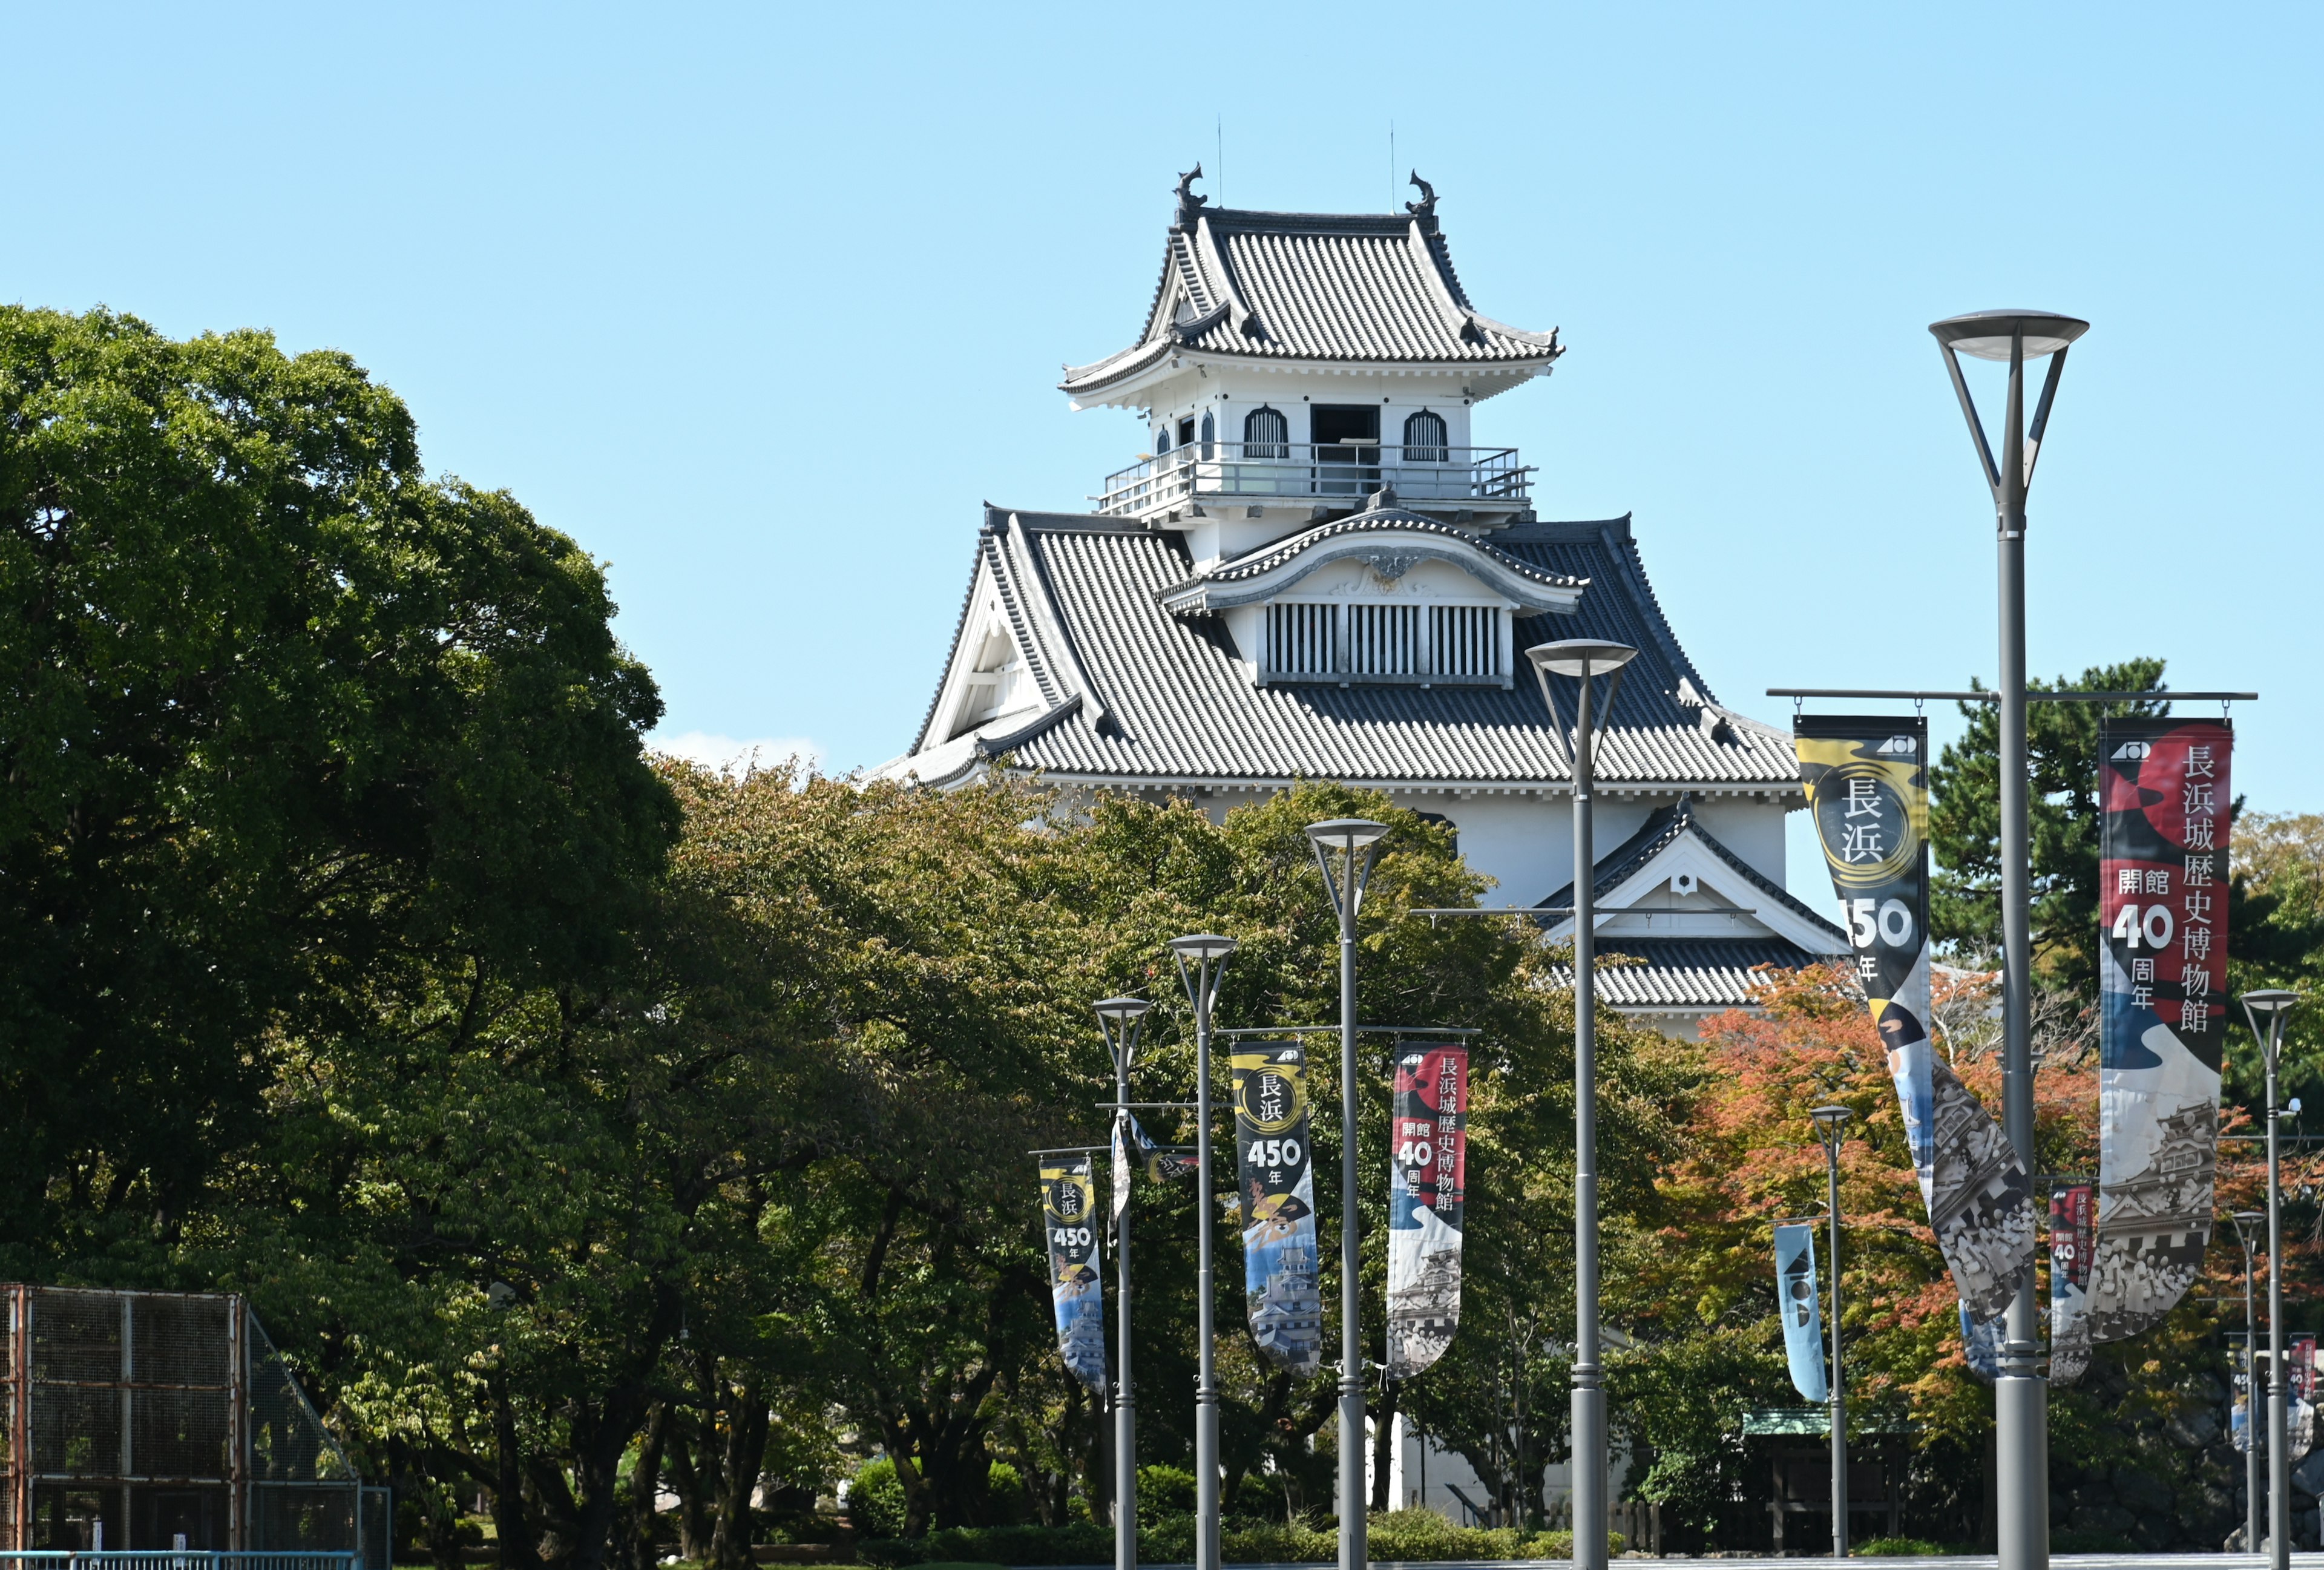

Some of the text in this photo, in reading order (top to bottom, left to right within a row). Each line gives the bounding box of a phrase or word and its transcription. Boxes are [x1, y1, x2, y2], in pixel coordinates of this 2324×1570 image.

[1842, 778, 1883, 862] 長浜
[2118, 869, 2169, 895] 開館
[2180, 746, 2216, 1033] 長浜城歴史博物館
[2112, 904, 2174, 949] 40
[1856, 955, 1879, 982] 年
[2131, 958, 2155, 1010] 周年
[1259, 1075, 1283, 1122] 長浜
[1402, 1122, 1431, 1137] 開館
[1435, 1057, 1458, 1212] 長浜城歴史博物館
[1248, 1138, 1301, 1168] 450
[1398, 1141, 1432, 1166] 40
[1269, 1170, 1283, 1185] 年
[1407, 1170, 1421, 1198] 周年
[1060, 1183, 1078, 1215] 長浜
[1054, 1227, 1091, 1246] 450
[2076, 1193, 2088, 1286] 長浜城歴史博物館
[1069, 1248, 1080, 1258] 年
[2054, 1244, 2075, 1260] 40
[2290, 1374, 2303, 1384] 40
